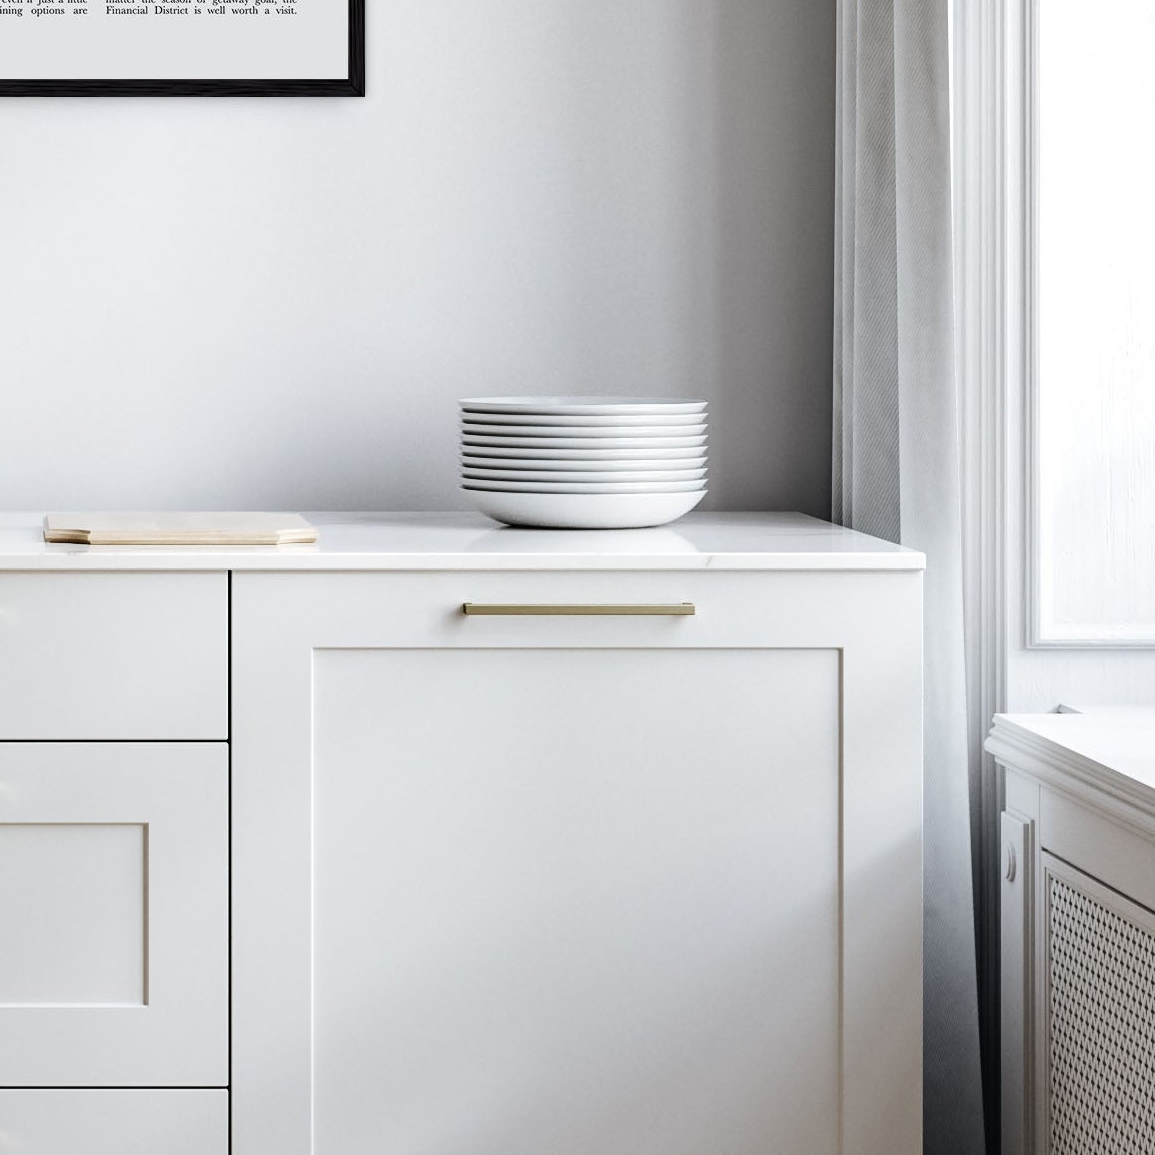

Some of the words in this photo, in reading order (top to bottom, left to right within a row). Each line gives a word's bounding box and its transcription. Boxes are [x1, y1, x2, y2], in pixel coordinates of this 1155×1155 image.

[30, 6, 65, 17] options
[106, 6, 148, 14] Financial
[154, 6, 188, 14] District
[194, 6, 202, 14] is
[207, 6, 225, 14] well
[231, 6, 258, 14] worth
[275, 6, 297, 14] visit.
